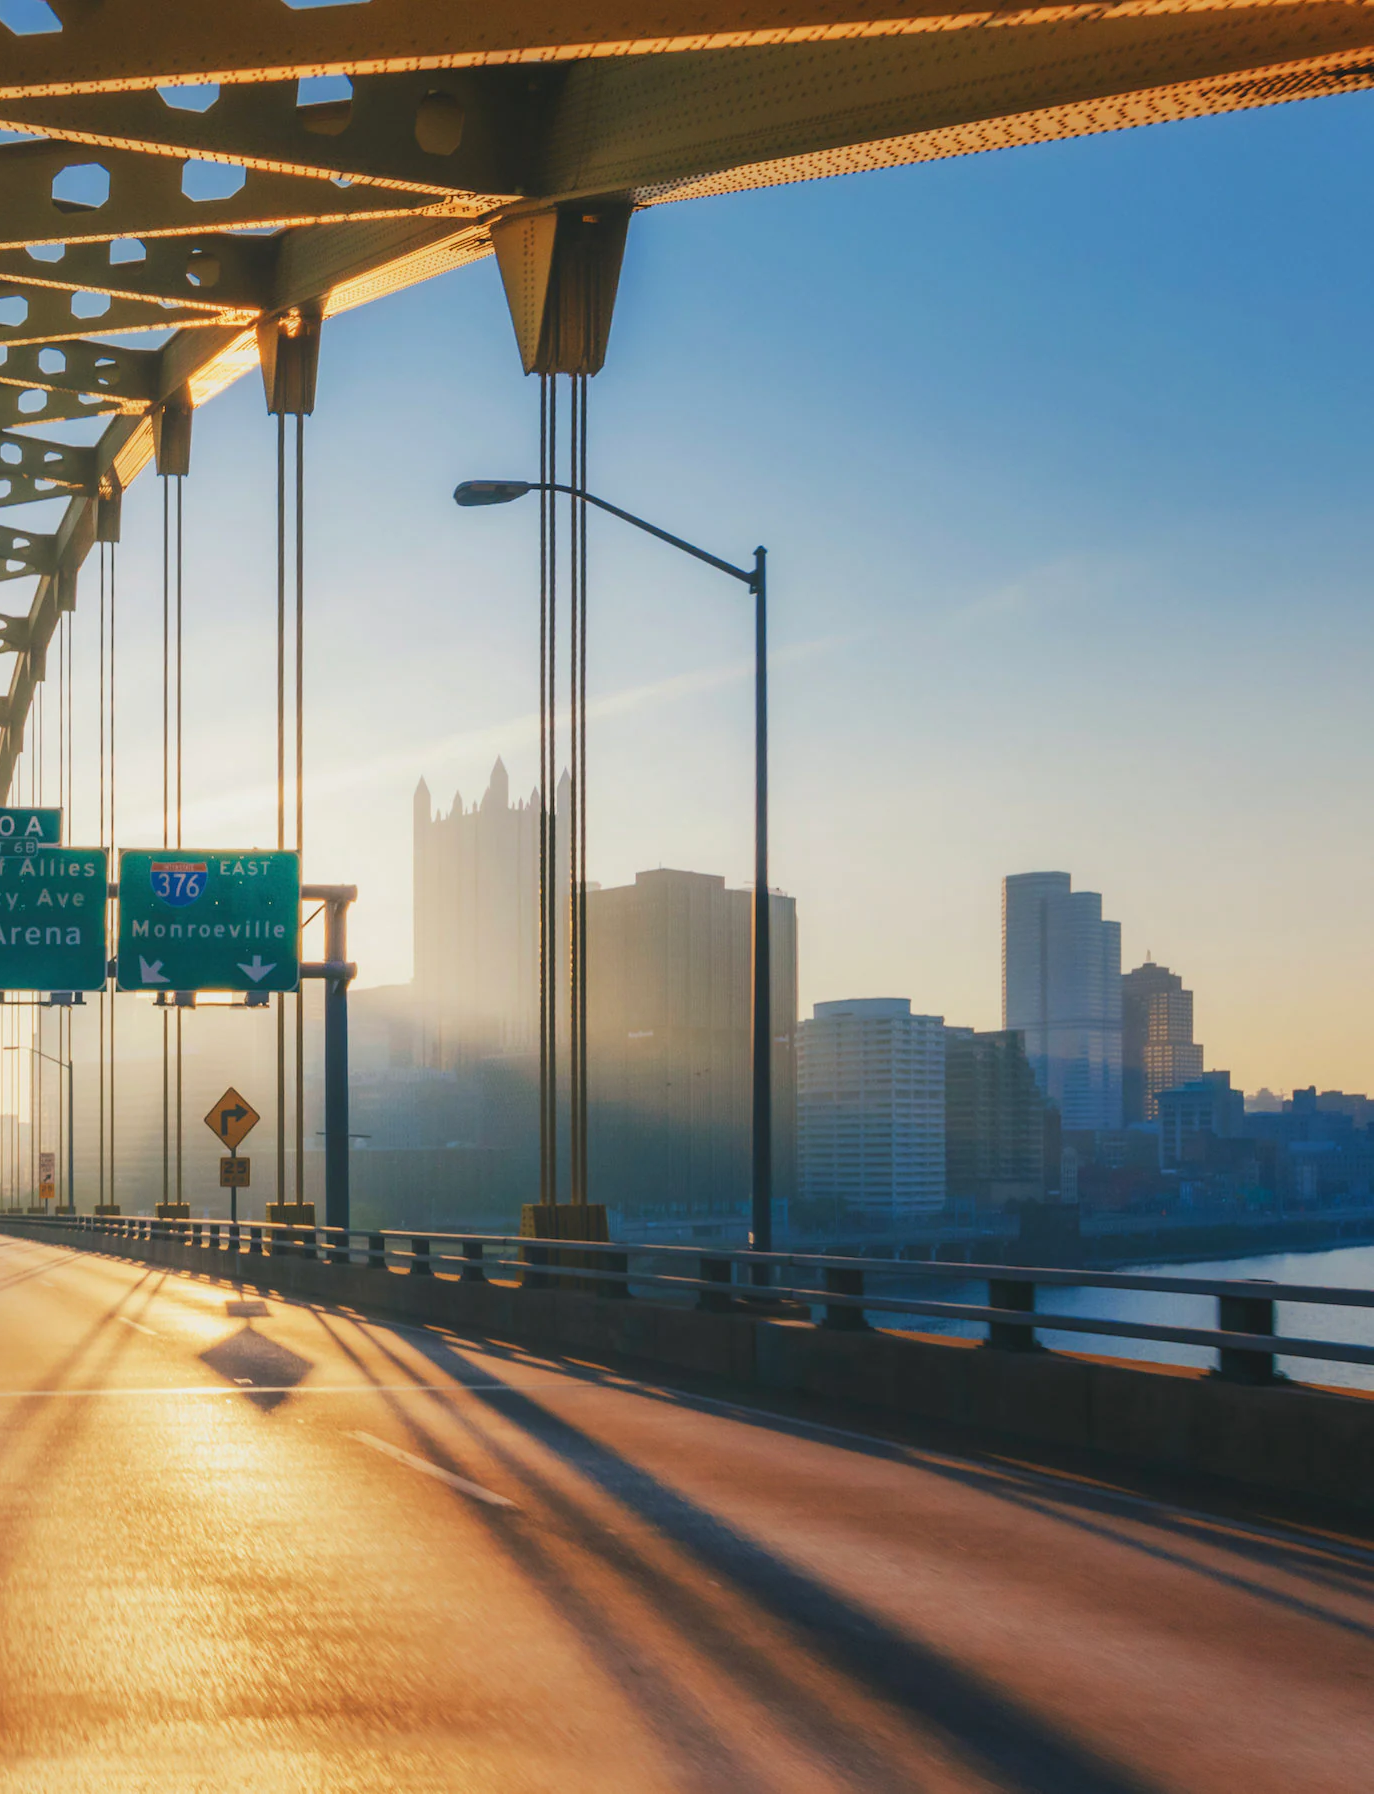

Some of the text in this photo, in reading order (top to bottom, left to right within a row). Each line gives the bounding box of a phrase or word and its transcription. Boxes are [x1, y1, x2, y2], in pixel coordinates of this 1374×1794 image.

[14, 841, 37, 853] 6B
[19, 857, 96, 877] Allies
[219, 861, 271, 876] EAST
[156, 873, 200, 897] 376
[37, 888, 85, 906] Ave
[131, 920, 286, 939] Monroeville
[223, 1161, 247, 1174] 25
